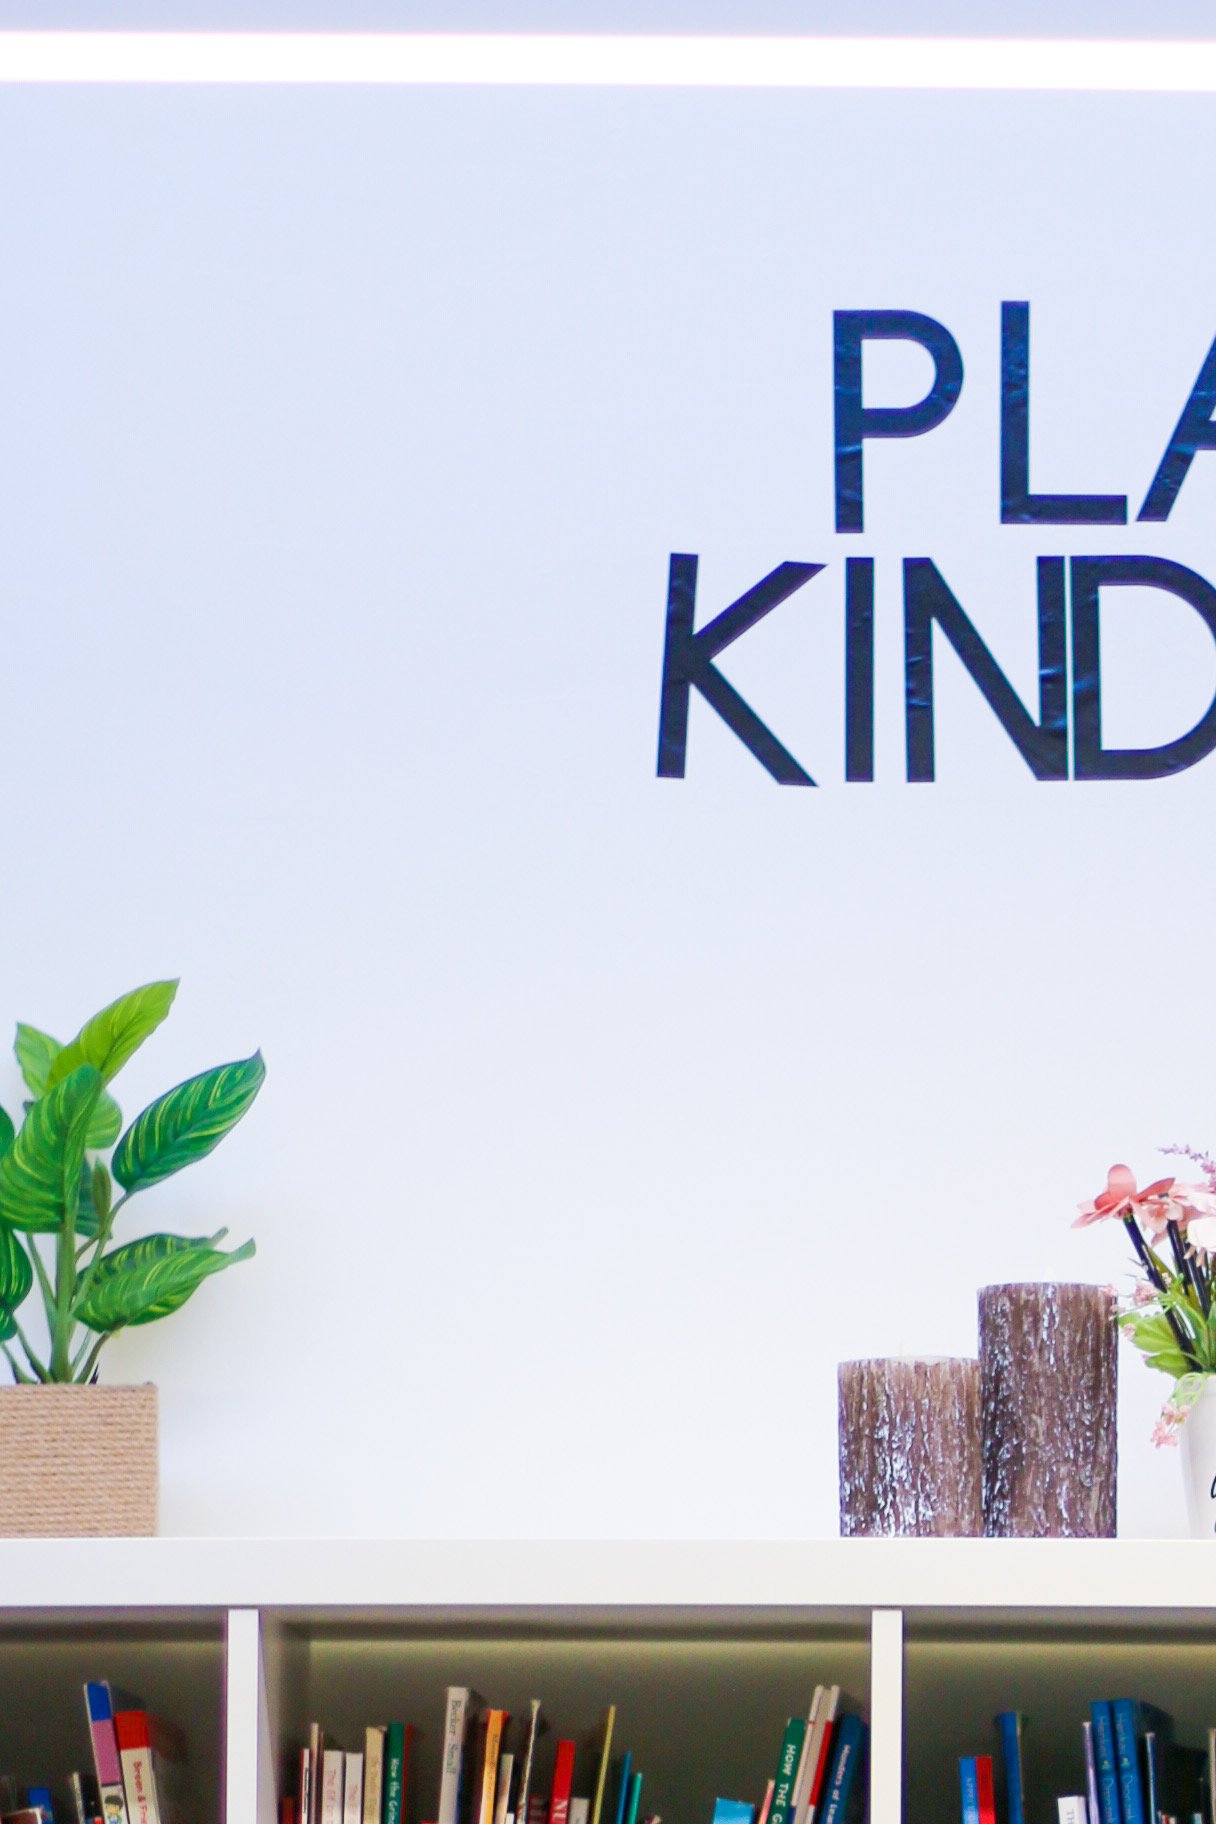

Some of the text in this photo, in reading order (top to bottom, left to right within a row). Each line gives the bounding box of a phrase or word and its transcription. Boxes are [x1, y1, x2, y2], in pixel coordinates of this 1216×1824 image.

[390, 1758, 400, 1778] How
[782, 1744, 796, 1776] HOW
[389, 1781, 399, 1797] the
[776, 1782, 790, 1806] THE
